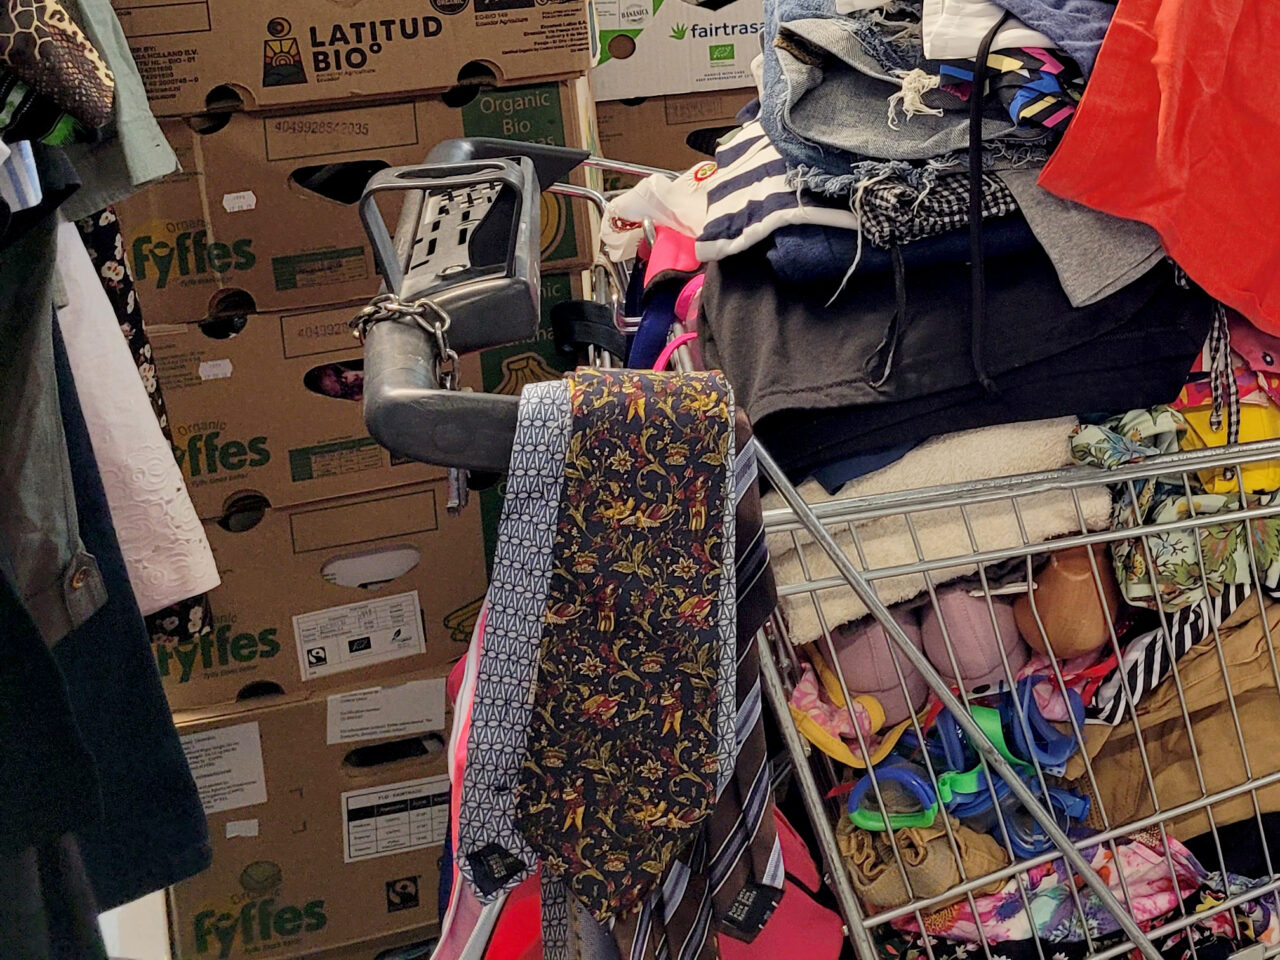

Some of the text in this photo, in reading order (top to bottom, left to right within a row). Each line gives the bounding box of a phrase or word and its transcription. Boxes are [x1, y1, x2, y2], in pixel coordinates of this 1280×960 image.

[309, 16, 443, 49] LATITUD
[480, 91, 550, 114] Organic
[502, 118, 531, 136] Bio
[132, 230, 256, 289] fyffes
